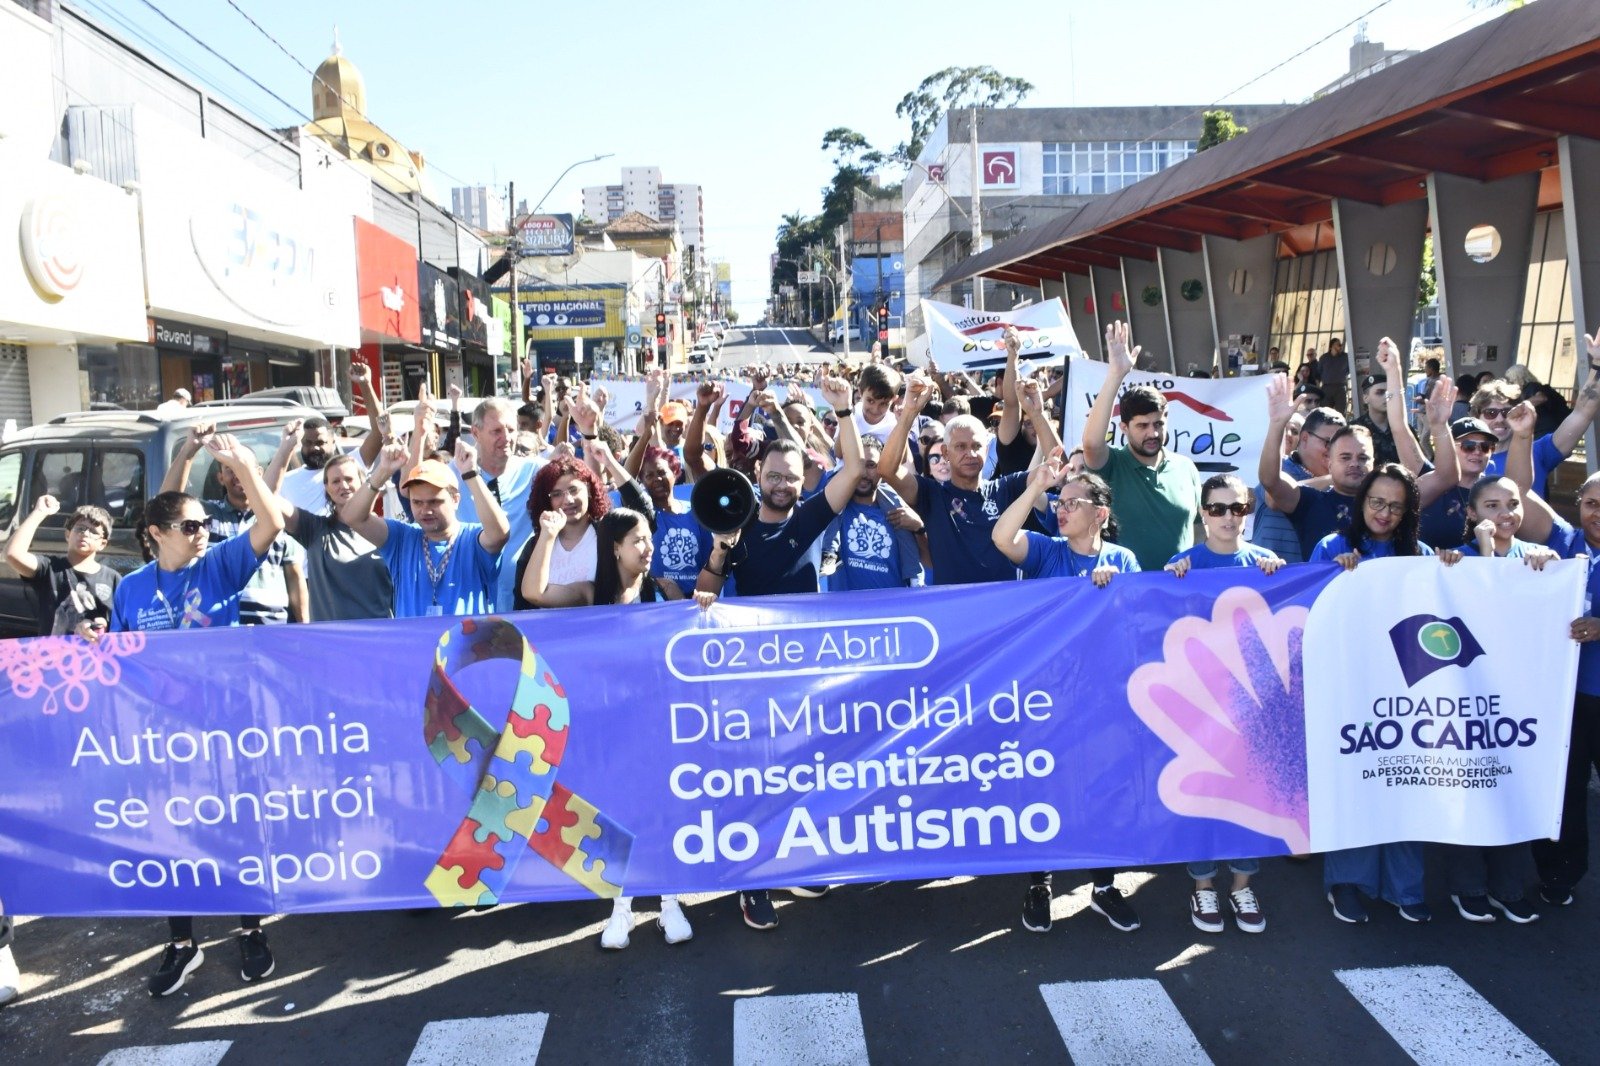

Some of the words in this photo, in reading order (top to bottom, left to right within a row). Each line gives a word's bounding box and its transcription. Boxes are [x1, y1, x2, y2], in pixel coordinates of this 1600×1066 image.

[519, 303, 551, 313] LETRO
[553, 301, 602, 312] NACIONAL
[954, 315, 1001, 329] nstituto
[702, 637, 748, 668] 02
[758, 633, 804, 664] de
[815, 626, 901, 662] Abril
[670, 698, 751, 744] Dia
[768, 682, 973, 739] Mundial
[988, 680, 1053, 725] de
[1373, 696, 1471, 718] CIDADE
[1475, 694, 1500, 716] DE
[71, 712, 370, 767] Autonomia
[1340, 719, 1404, 755] SÃO
[1411, 716, 1538, 751] CARLOS
[669, 741, 1055, 800] Conscientização
[1362, 769, 1376, 780] DA
[1378, 766, 1421, 778] PESSOA
[1423, 765, 1454, 778] COM
[1457, 764, 1513, 778] DEFICIÊNCIA
[1377, 754, 1445, 767] SECRETARIA
[1447, 754, 1501, 767] MUNICIPAL
[93, 797, 150, 829] se
[164, 775, 375, 827] constrói
[1386, 777, 1393, 787] E
[1395, 776, 1498, 789] PARADESPORTOS
[672, 810, 760, 865] do
[775, 794, 1061, 861] Autismo
[108, 856, 222, 888] com
[238, 840, 382, 894] apoio
